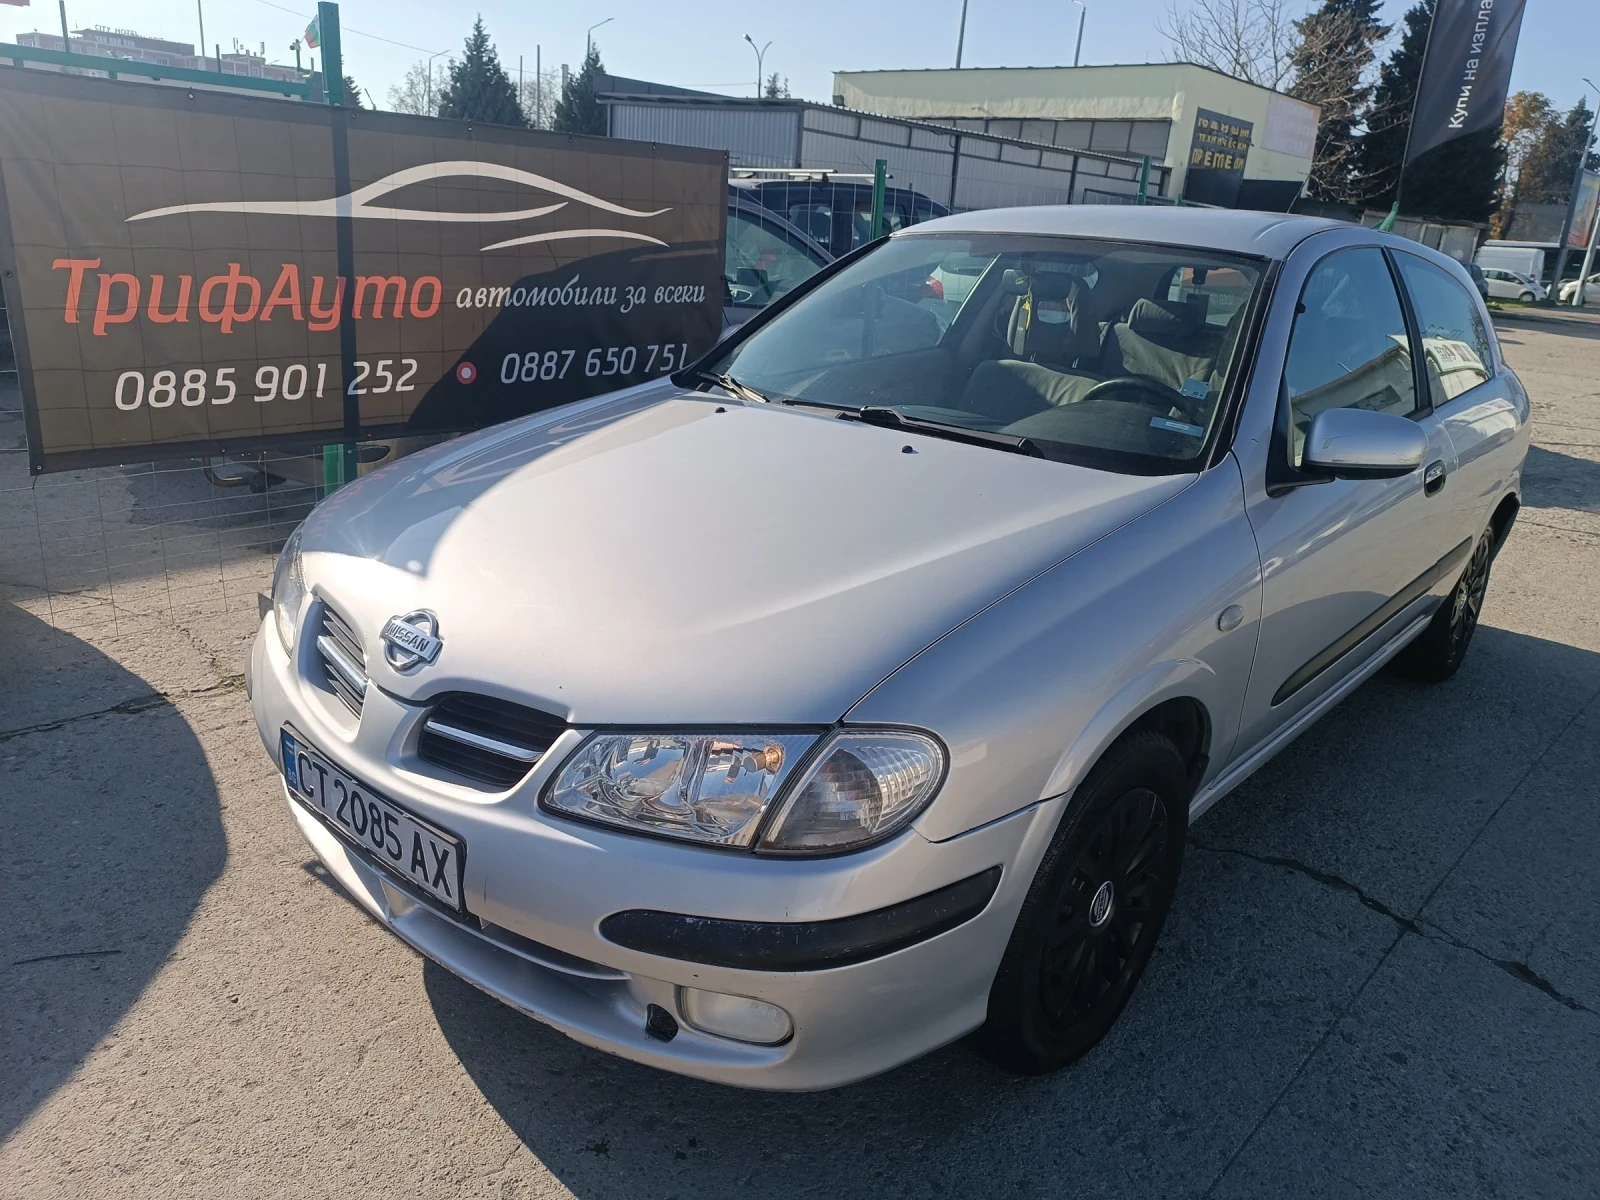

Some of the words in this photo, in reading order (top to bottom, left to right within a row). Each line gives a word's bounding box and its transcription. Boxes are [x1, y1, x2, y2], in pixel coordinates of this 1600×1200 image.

[94, 24, 111, 33] CITY
[114, 28, 138, 36] HOTEL
[1448, 85, 1472, 128] Купи
[1463, 58, 1479, 80] на
[52, 258, 442, 336] ТрифАуто
[455, 274, 617, 308] автомобили
[620, 285, 647, 314] за
[653, 284, 706, 304] всеки
[501, 349, 576, 384] 0887
[584, 346, 637, 377] 650
[645, 343, 688, 373] 751
[114, 369, 236, 411] 0885
[253, 363, 326, 403] 901
[347, 358, 418, 395] 252
[386, 621, 430, 653] NISSAN
[287, 767, 297, 785] BG
[297, 751, 330, 808] CT
[334, 775, 403, 860] 2085
[410, 830, 453, 898] AX
